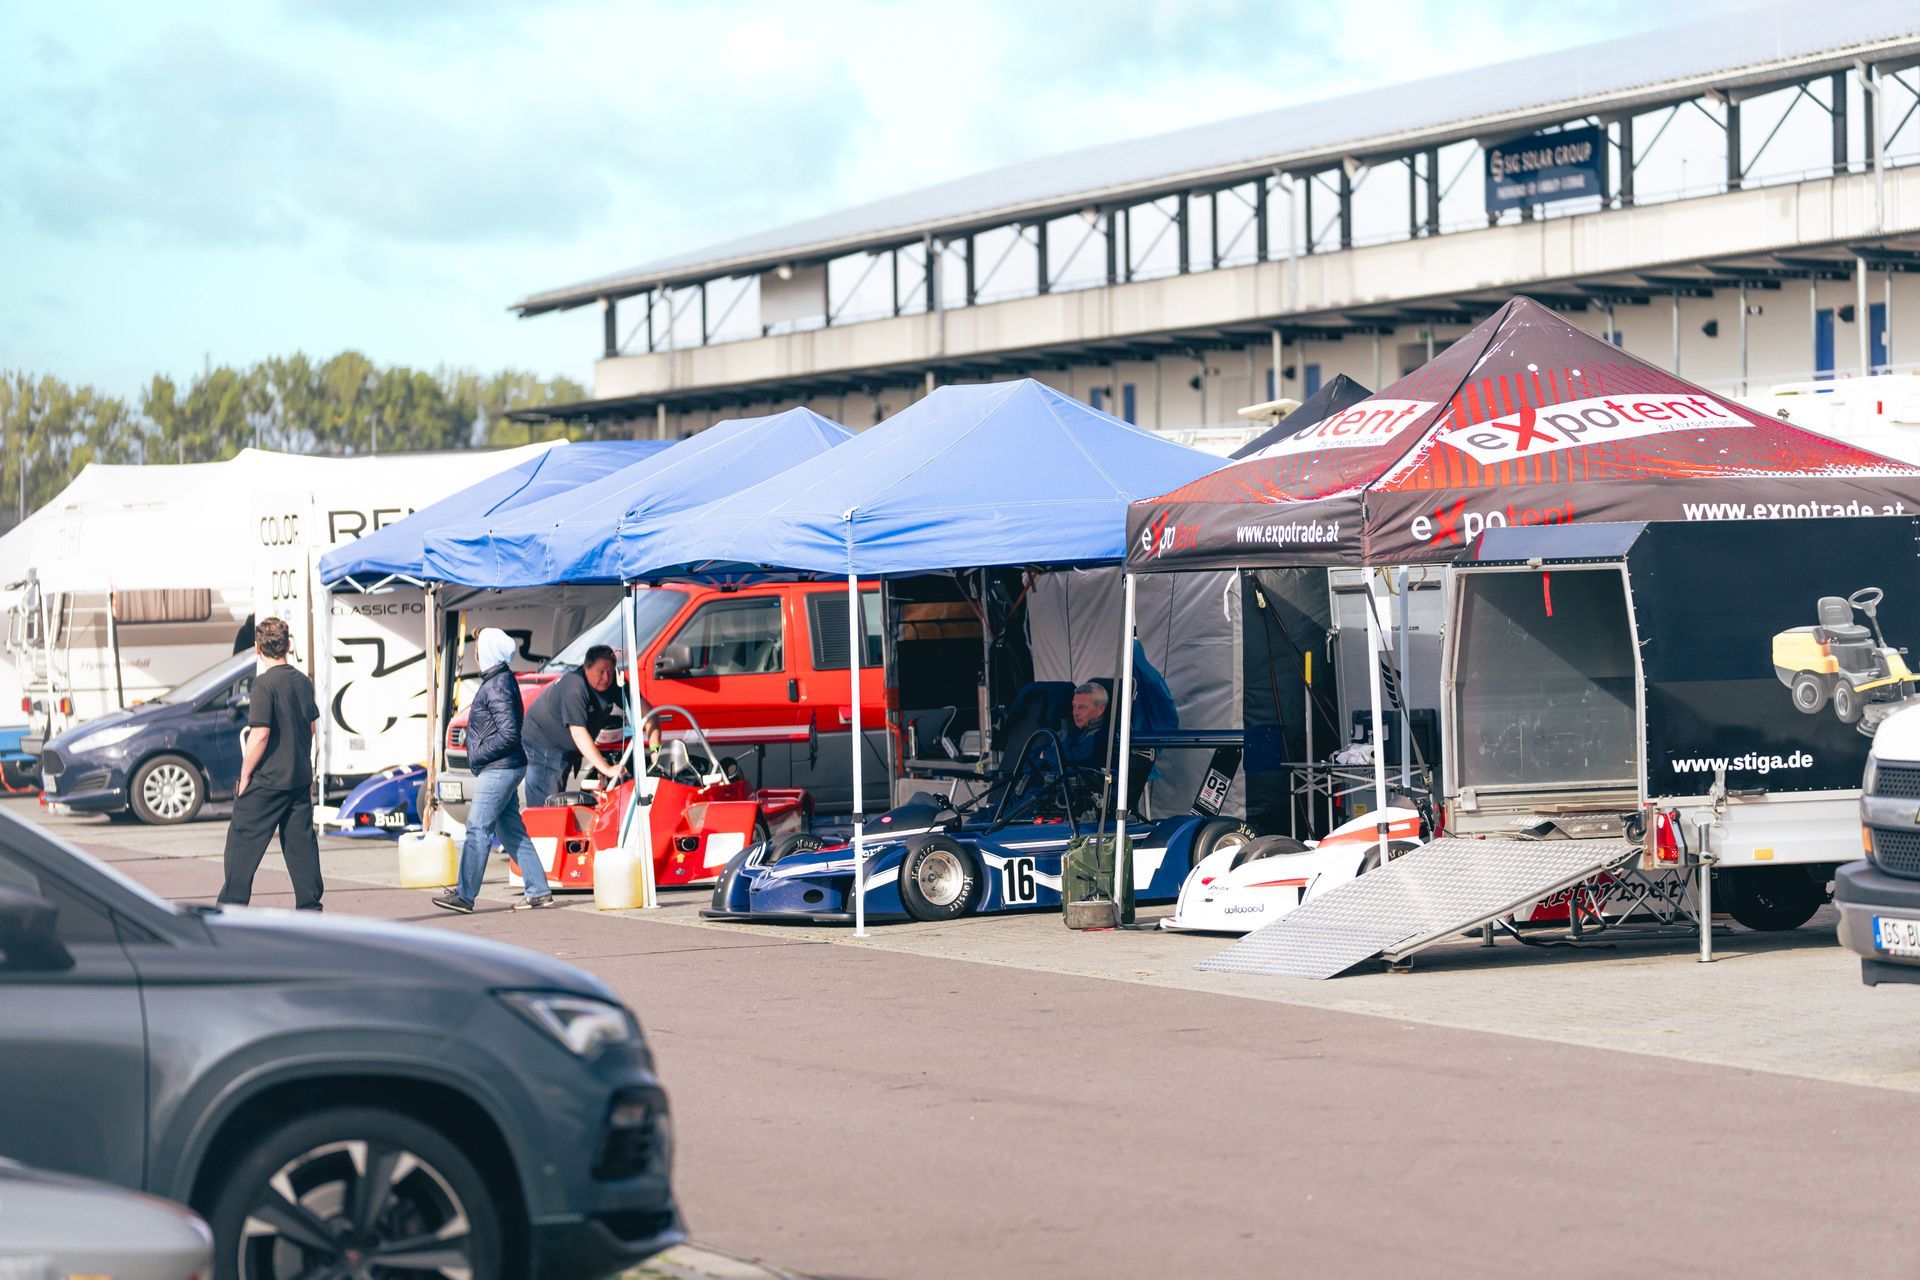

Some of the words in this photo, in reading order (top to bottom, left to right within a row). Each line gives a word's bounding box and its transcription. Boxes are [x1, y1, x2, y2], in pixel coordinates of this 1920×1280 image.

[1522, 147, 1553, 172] SOLAR
[1554, 141, 1593, 166] GROUP
[1683, 500, 1905, 521] www.expotradeat
[1237, 519, 1340, 548] www.expotrade.at
[272, 569, 297, 600] DOC
[331, 604, 397, 616] CLASSIC
[1671, 750, 1814, 775] www.stiga.de
[374, 812, 405, 827] Bull
[949, 873, 974, 912] Hoosier
[1003, 858, 1036, 902] 16
[1224, 903, 1265, 915] wilwood
